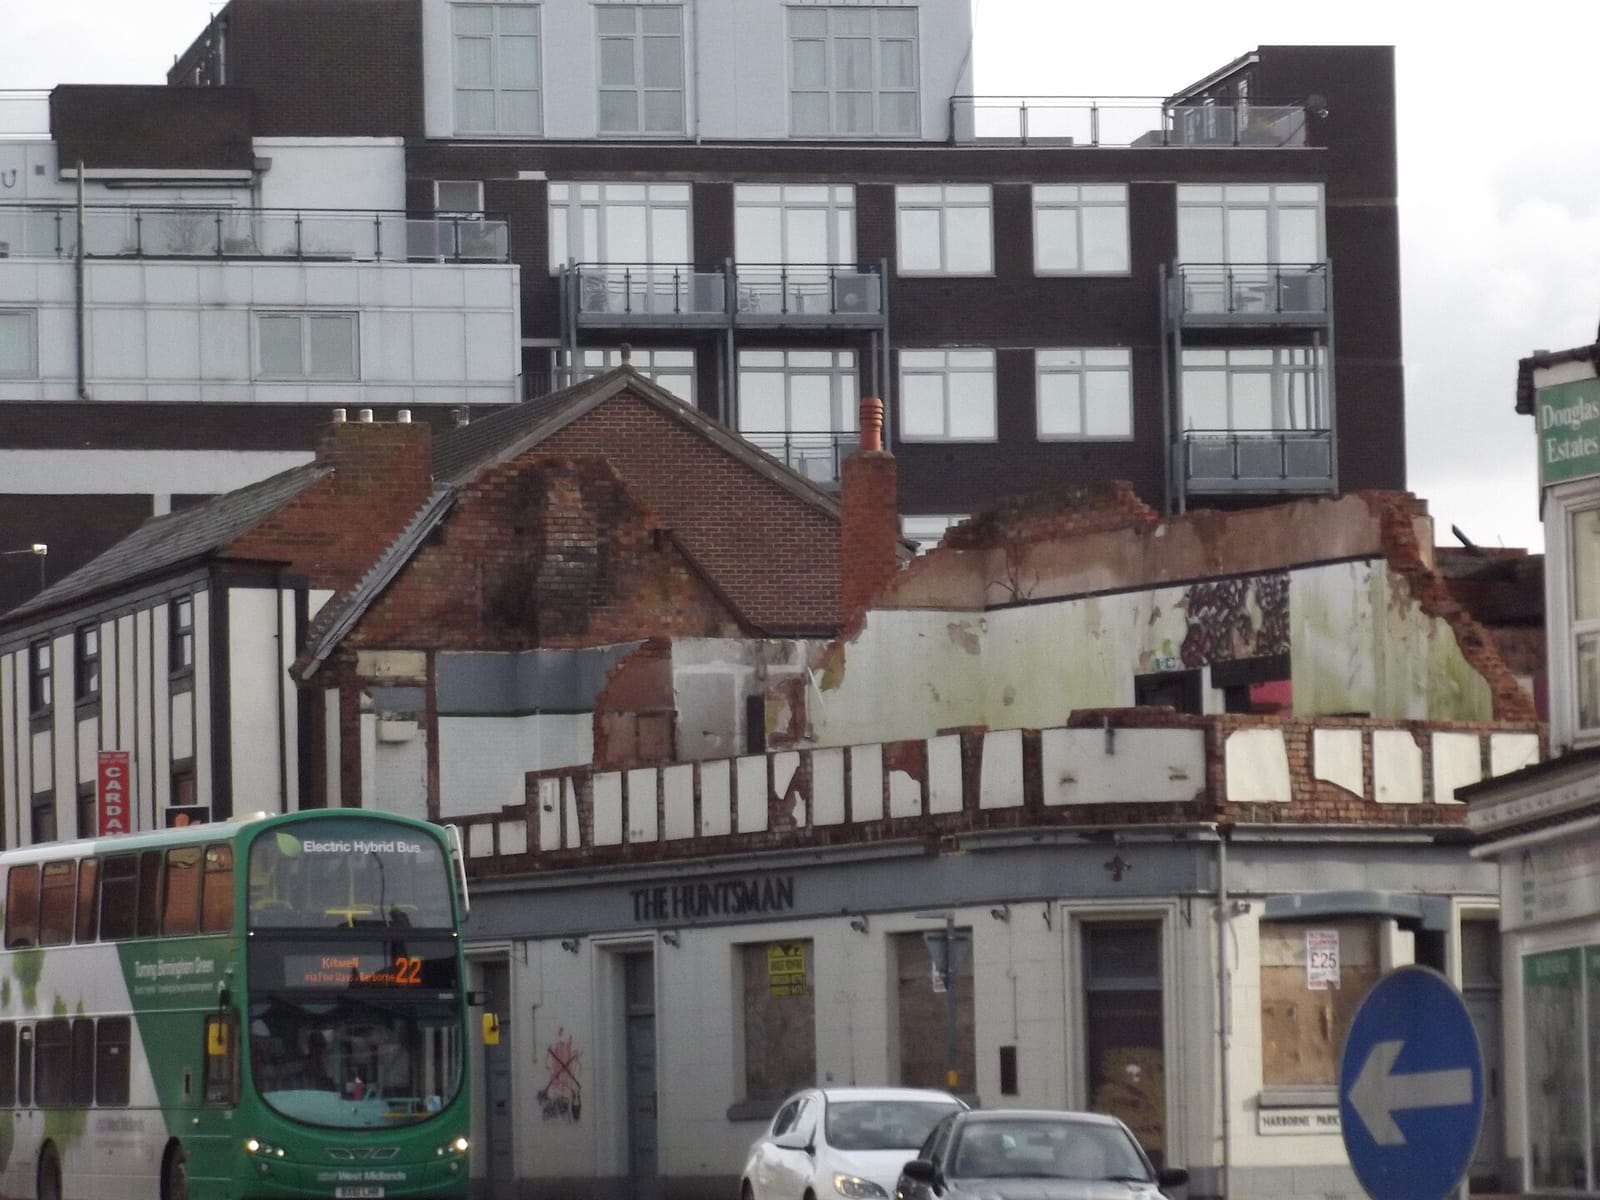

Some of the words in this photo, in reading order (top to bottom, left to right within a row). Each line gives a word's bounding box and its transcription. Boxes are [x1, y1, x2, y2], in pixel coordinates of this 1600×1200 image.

[1541, 397, 1599, 431] Douglas
[1546, 435, 1599, 463] Estates
[303, 840, 351, 853] Electric
[353, 840, 395, 855] Hybrid
[396, 841, 421, 854] Bus
[629, 886, 669, 922] THE
[671, 876, 794, 918] HUNTSMAN
[395, 957, 421, 983] 22
[1310, 951, 1337, 969] £25
[1263, 1115, 1310, 1127] HARBORNE
